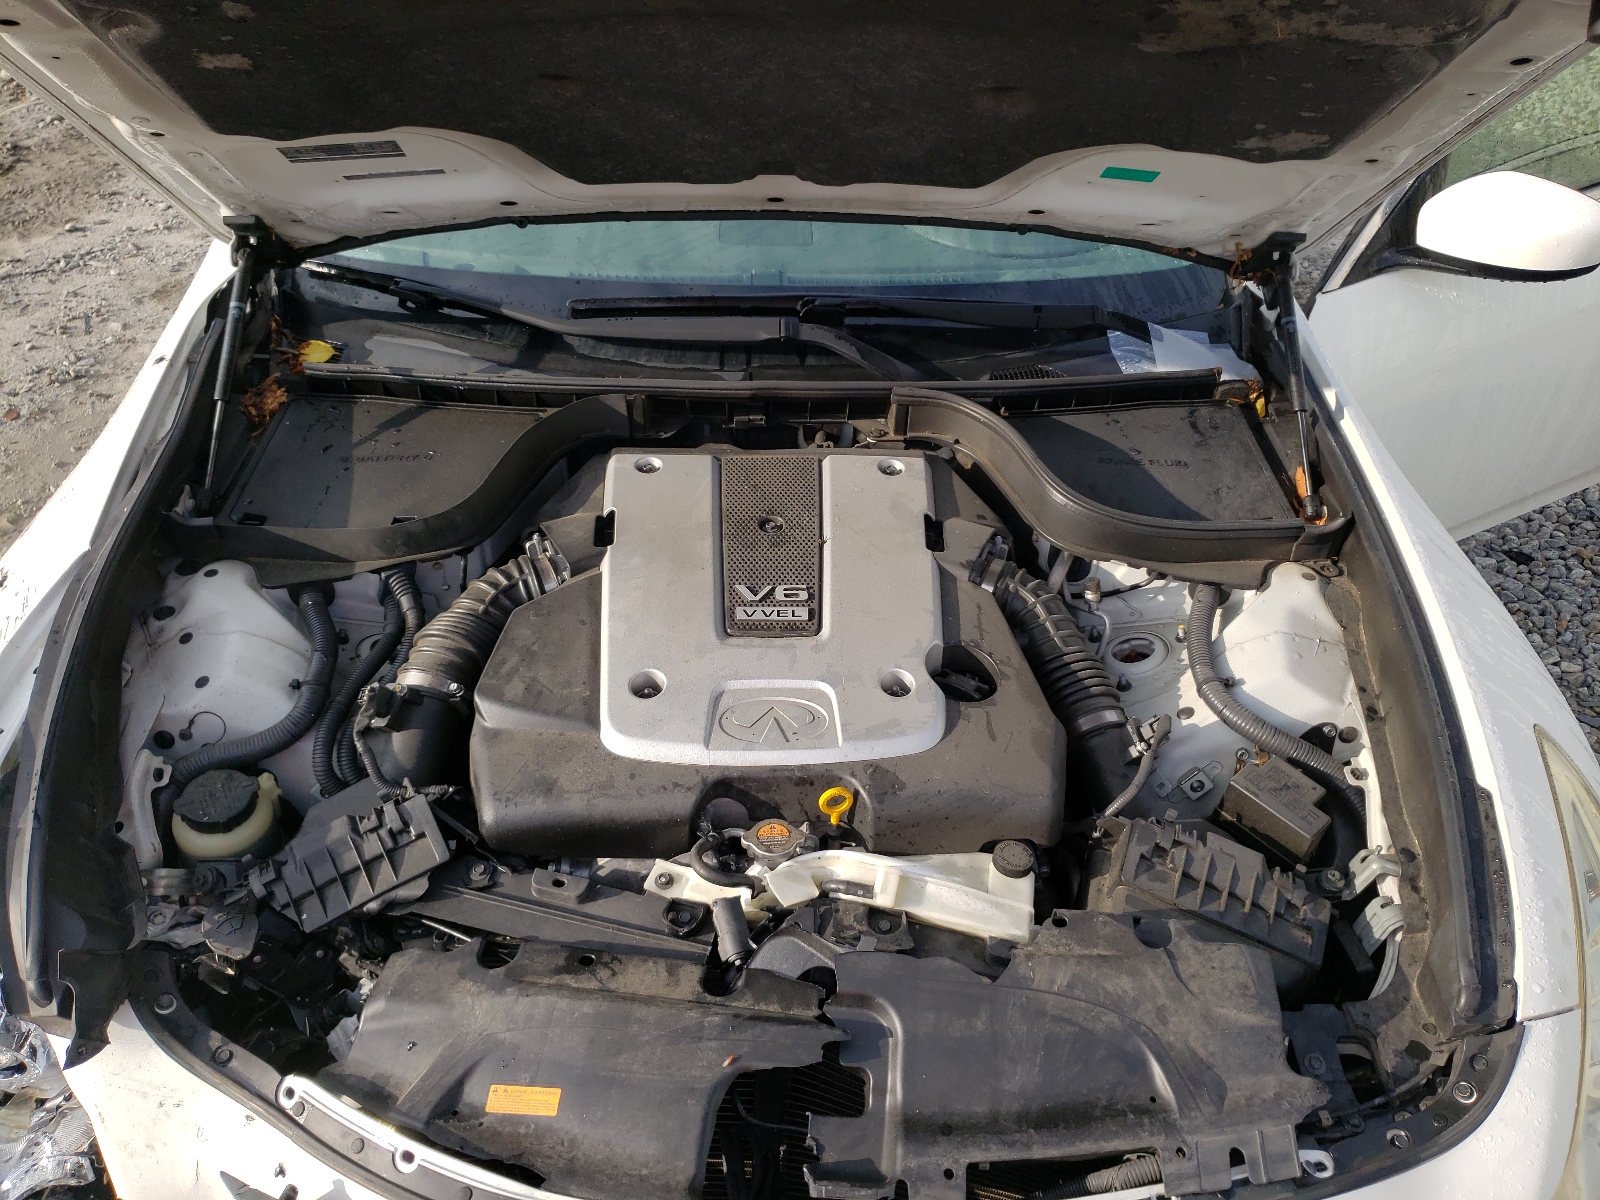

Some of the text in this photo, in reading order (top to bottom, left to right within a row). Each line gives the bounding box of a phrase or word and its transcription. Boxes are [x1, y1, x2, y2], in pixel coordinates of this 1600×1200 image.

[1147, 459, 1188, 468] FLUID
[734, 584, 809, 601] V6
[742, 609, 803, 618] VVEL
